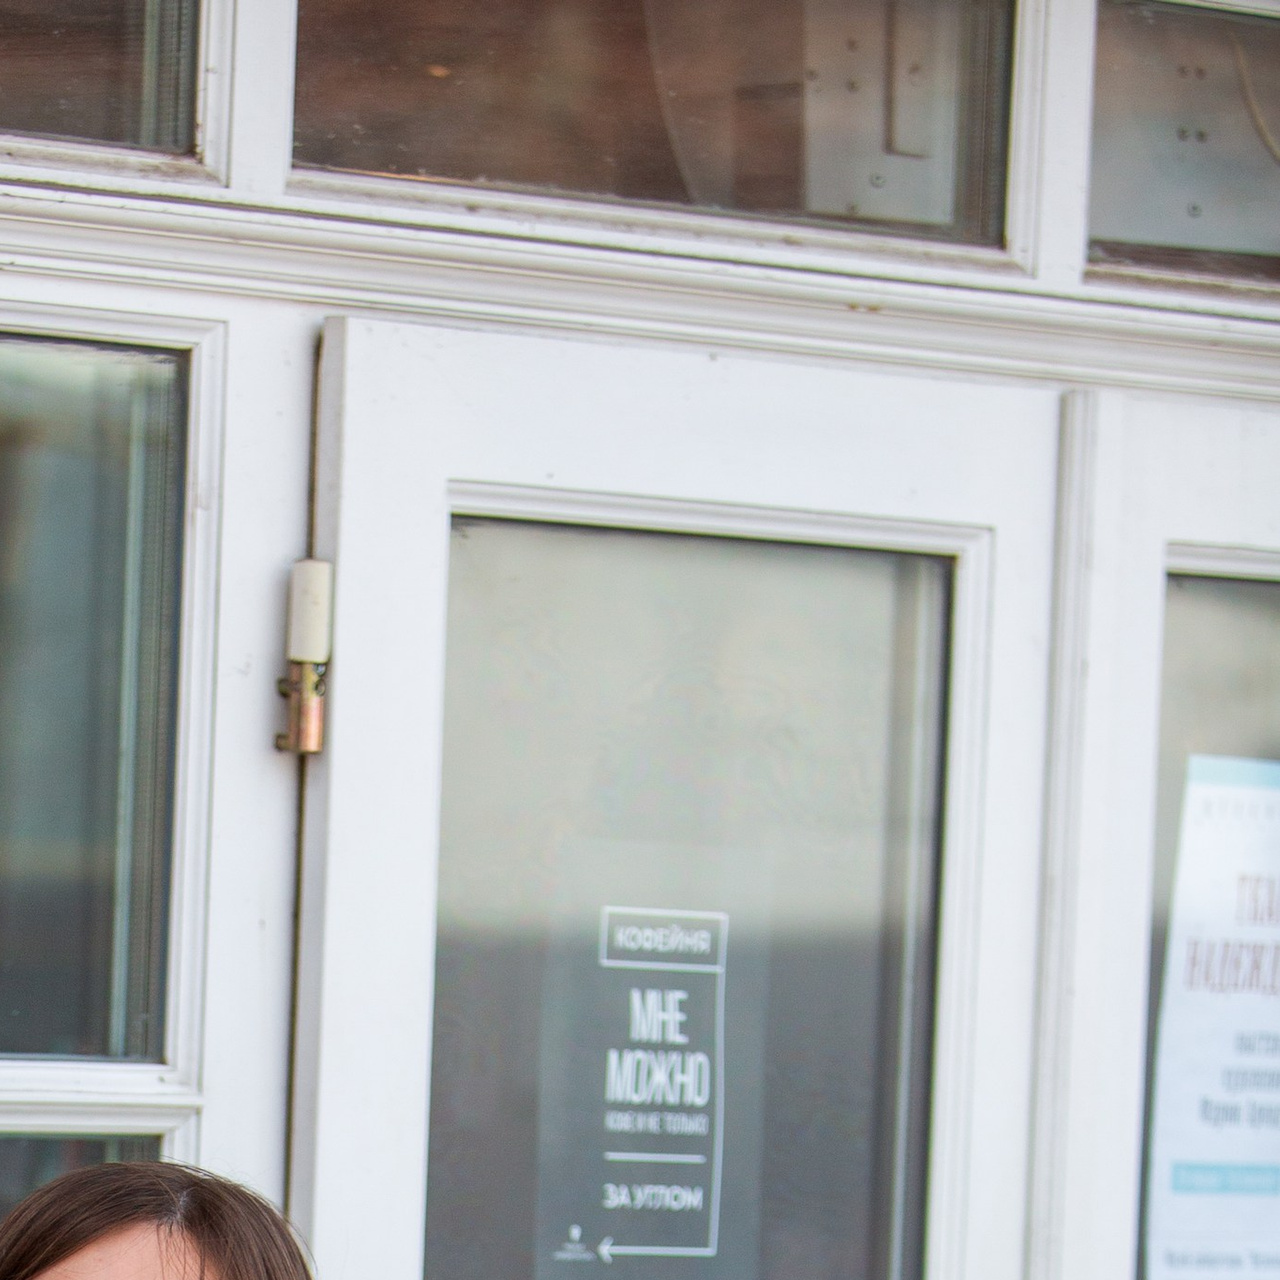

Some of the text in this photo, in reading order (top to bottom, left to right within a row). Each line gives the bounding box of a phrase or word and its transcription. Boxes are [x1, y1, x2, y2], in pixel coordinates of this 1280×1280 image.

[614, 924, 712, 954] КОФЕЙНЯ
[630, 987, 689, 1045] МНЕ
[605, 1048, 711, 1108] МОЖНО
[603, 1182, 703, 1211] ЗА УГЛОМ
